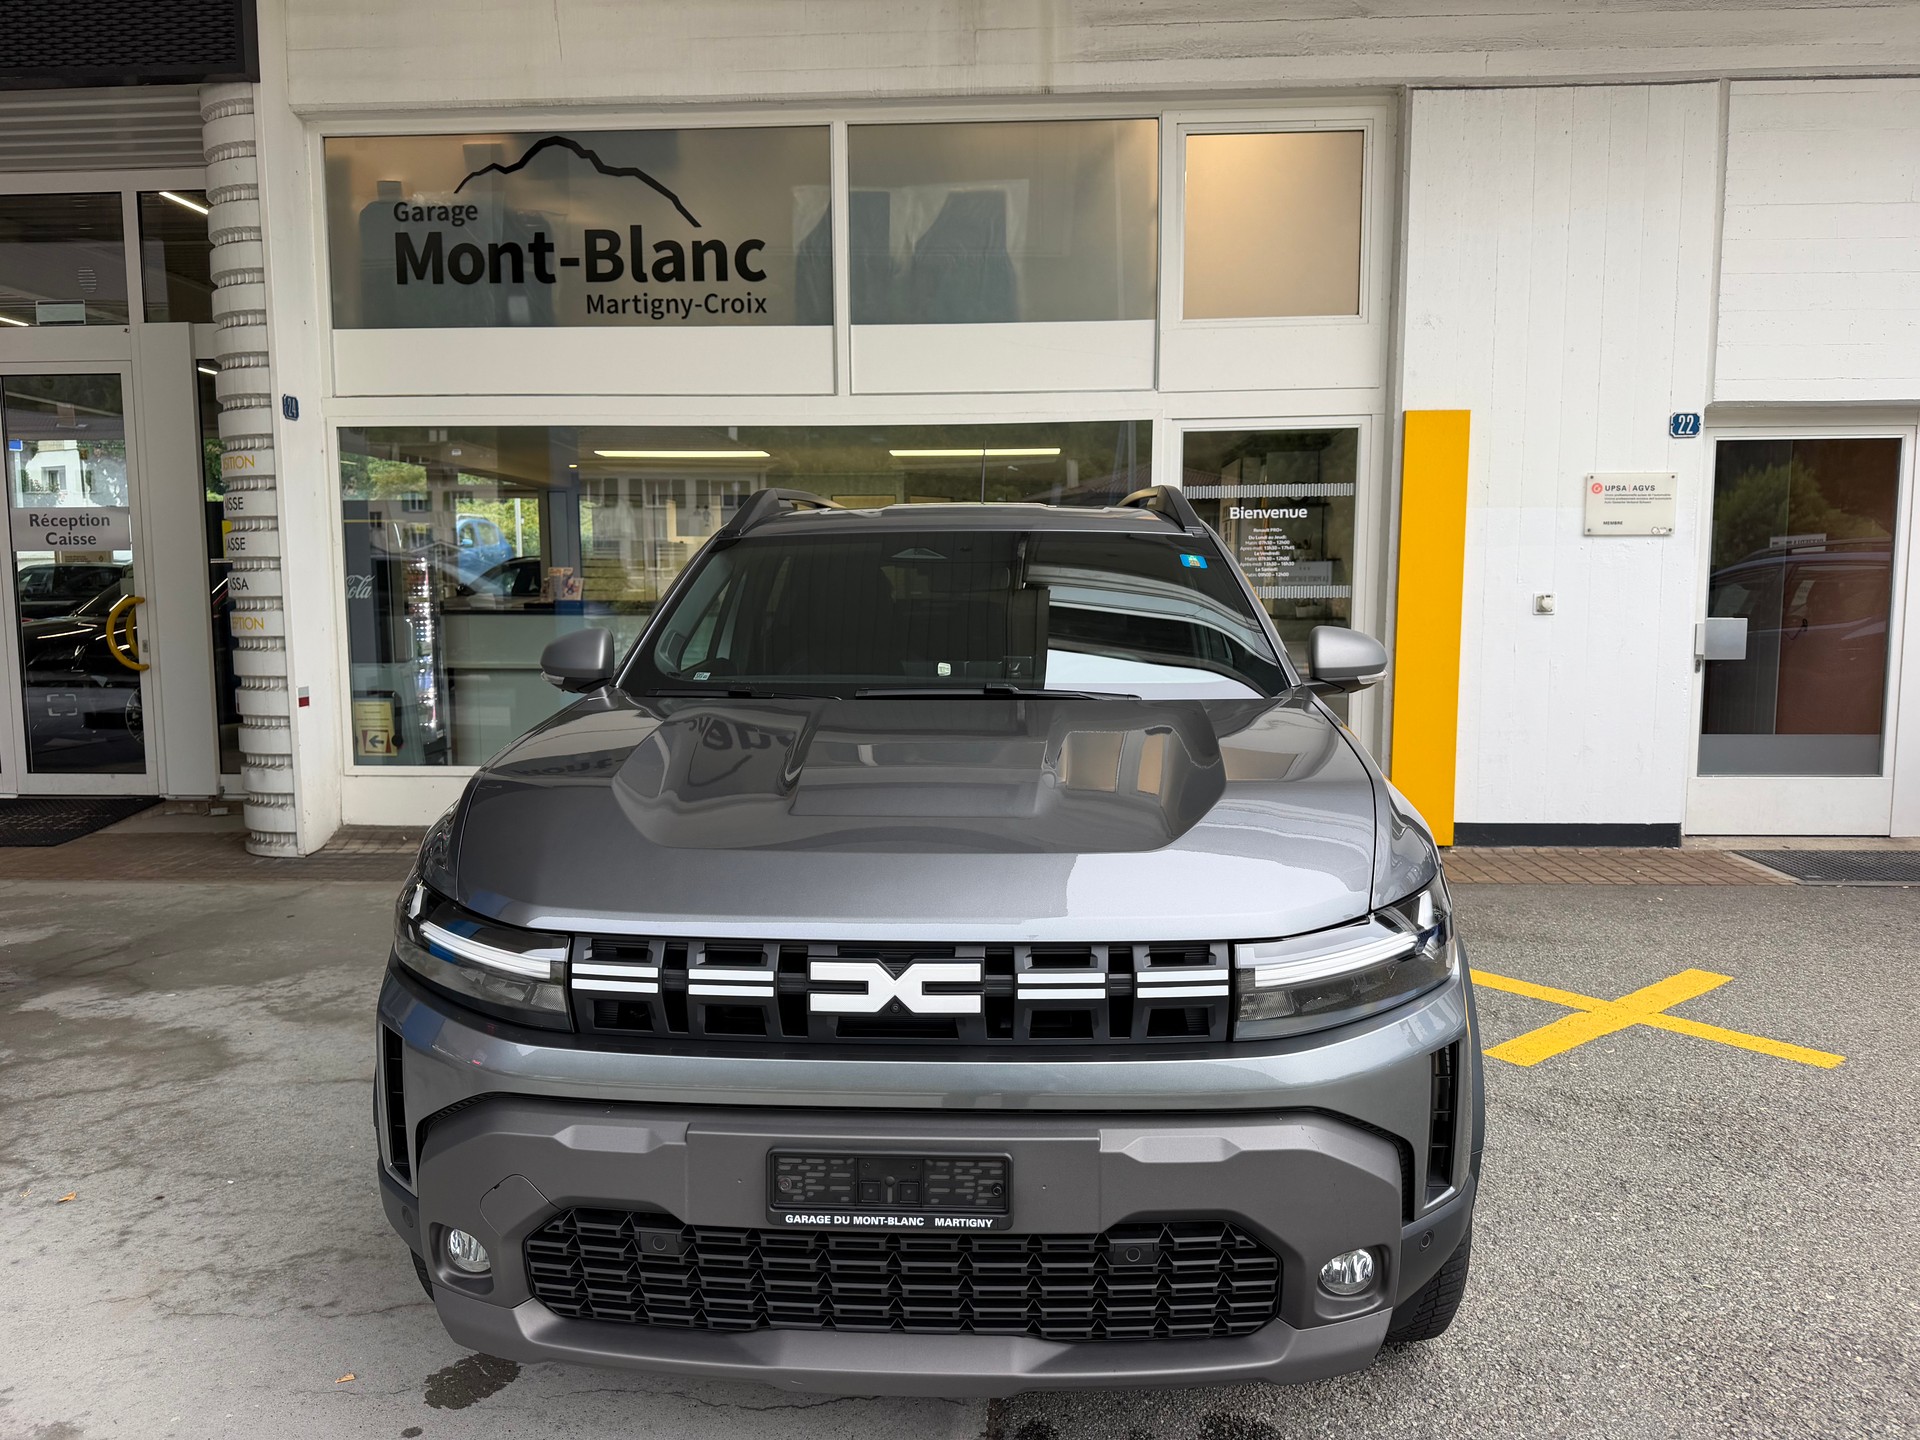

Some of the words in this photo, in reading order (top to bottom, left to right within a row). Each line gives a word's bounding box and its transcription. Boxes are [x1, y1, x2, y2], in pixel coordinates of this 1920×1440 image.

[393, 202, 478, 227] Garage
[395, 225, 767, 285] Mont-Blanc
[586, 292, 767, 320] Martigny-Croix
[287, 397, 297, 417] 24
[1677, 414, 1695, 434] 22
[1604, 484, 1627, 492] UPSA
[1632, 484, 1656, 492] AGVS
[29, 513, 110, 531] Réception
[1229, 506, 1308, 520] Bienvenue
[45, 532, 97, 546] Caisse
[785, 1214, 831, 1224] GARAGE
[834, 1215, 850, 1225] DU
[853, 1216, 924, 1226] MONT-BLANC
[935, 1217, 993, 1228] MARTIGNY
